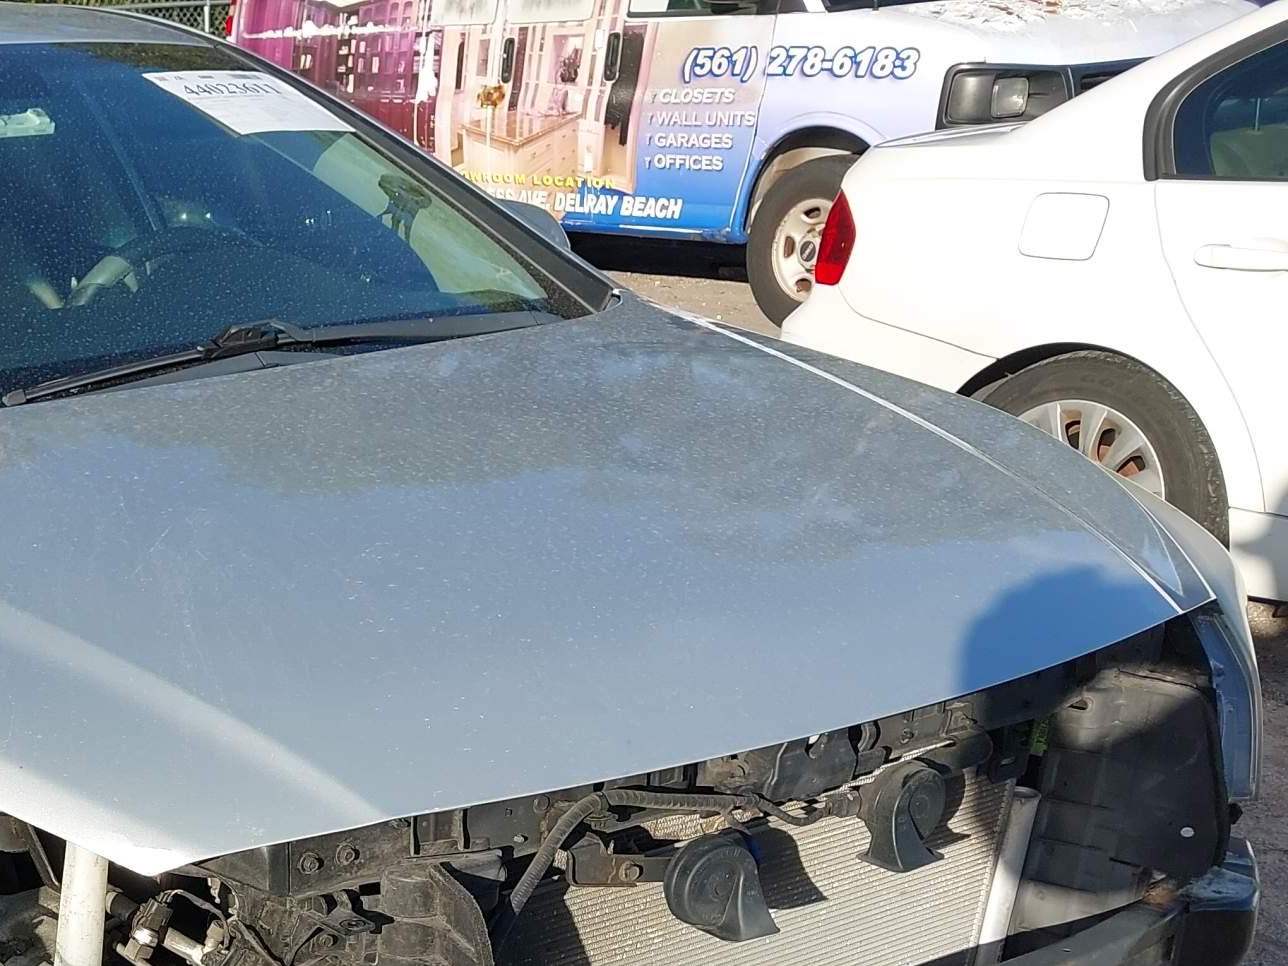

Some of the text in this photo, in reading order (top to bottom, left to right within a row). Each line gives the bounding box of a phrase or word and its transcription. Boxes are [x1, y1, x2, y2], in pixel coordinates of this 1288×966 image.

[683, 45, 920, 83] (561) 278-6183
[183, 82, 282, 97] 44023611
[658, 88, 735, 105] CLOSETS
[656, 111, 755, 127] WALL UNITS
[654, 133, 733, 149] GARAGES
[654, 154, 724, 170] OFFICES
[531, 173, 616, 189] LOCATION
[554, 191, 619, 216] DELRAY
[619, 195, 683, 219] BEACH
